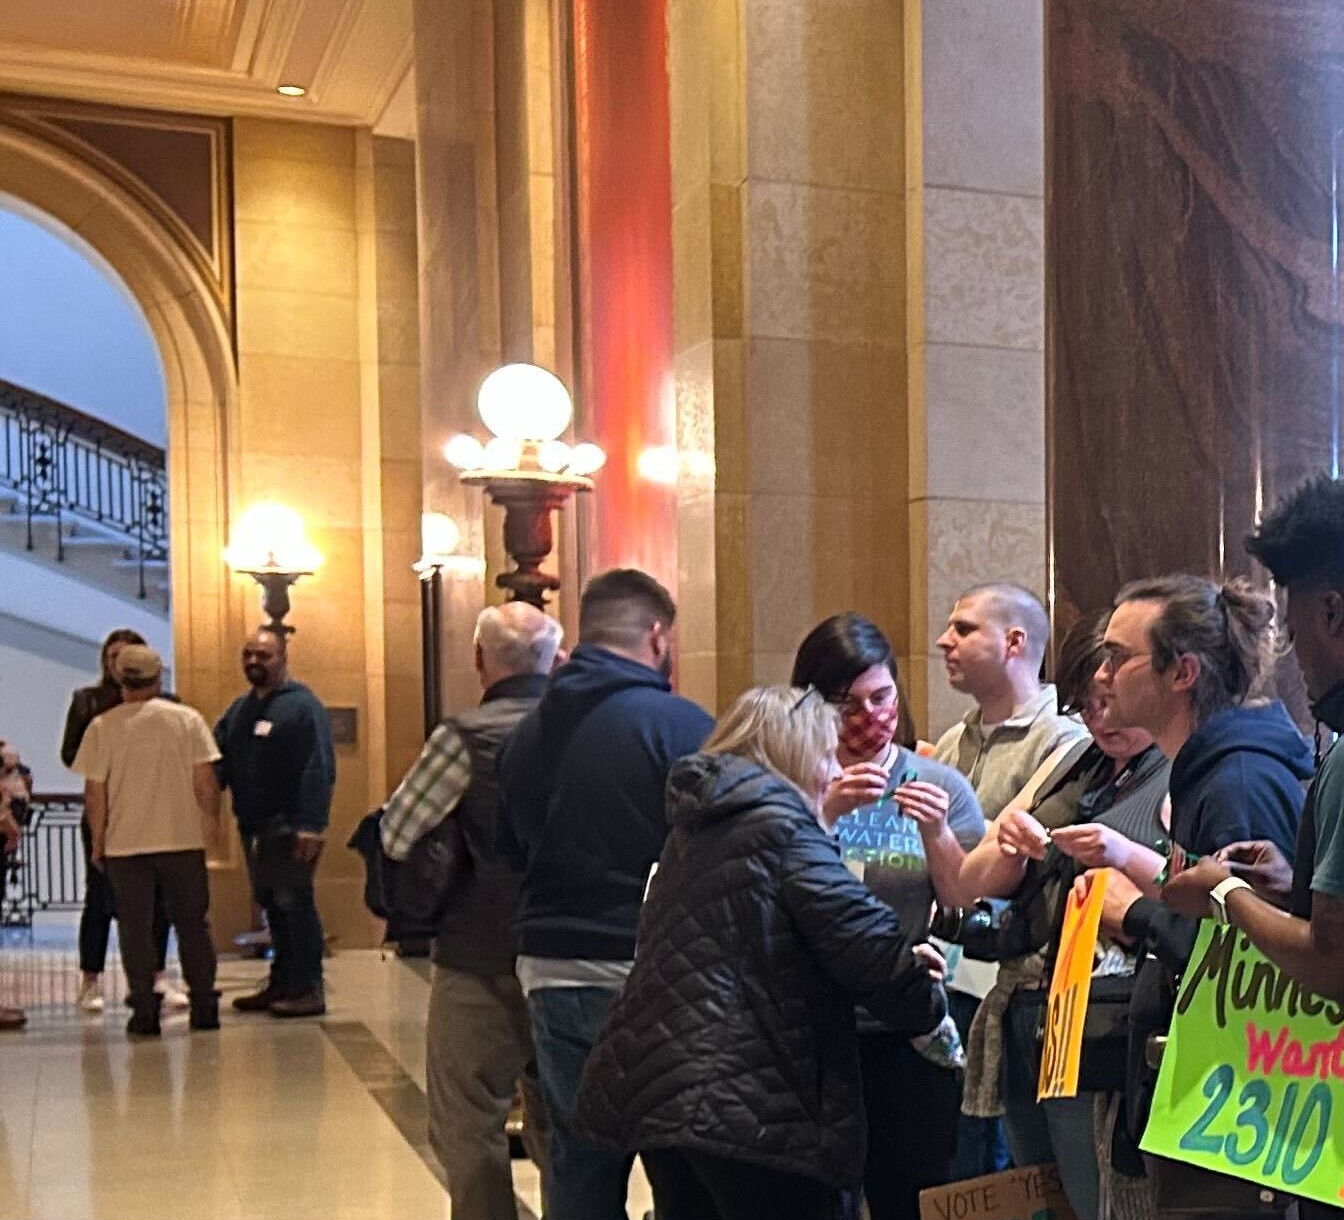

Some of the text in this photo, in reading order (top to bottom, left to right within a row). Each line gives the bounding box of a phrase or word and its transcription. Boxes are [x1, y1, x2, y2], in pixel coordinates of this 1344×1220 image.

[837, 810, 918, 835] CLEAN
[833, 827, 921, 855] WATER
[1179, 1064, 1333, 1185] 2310
